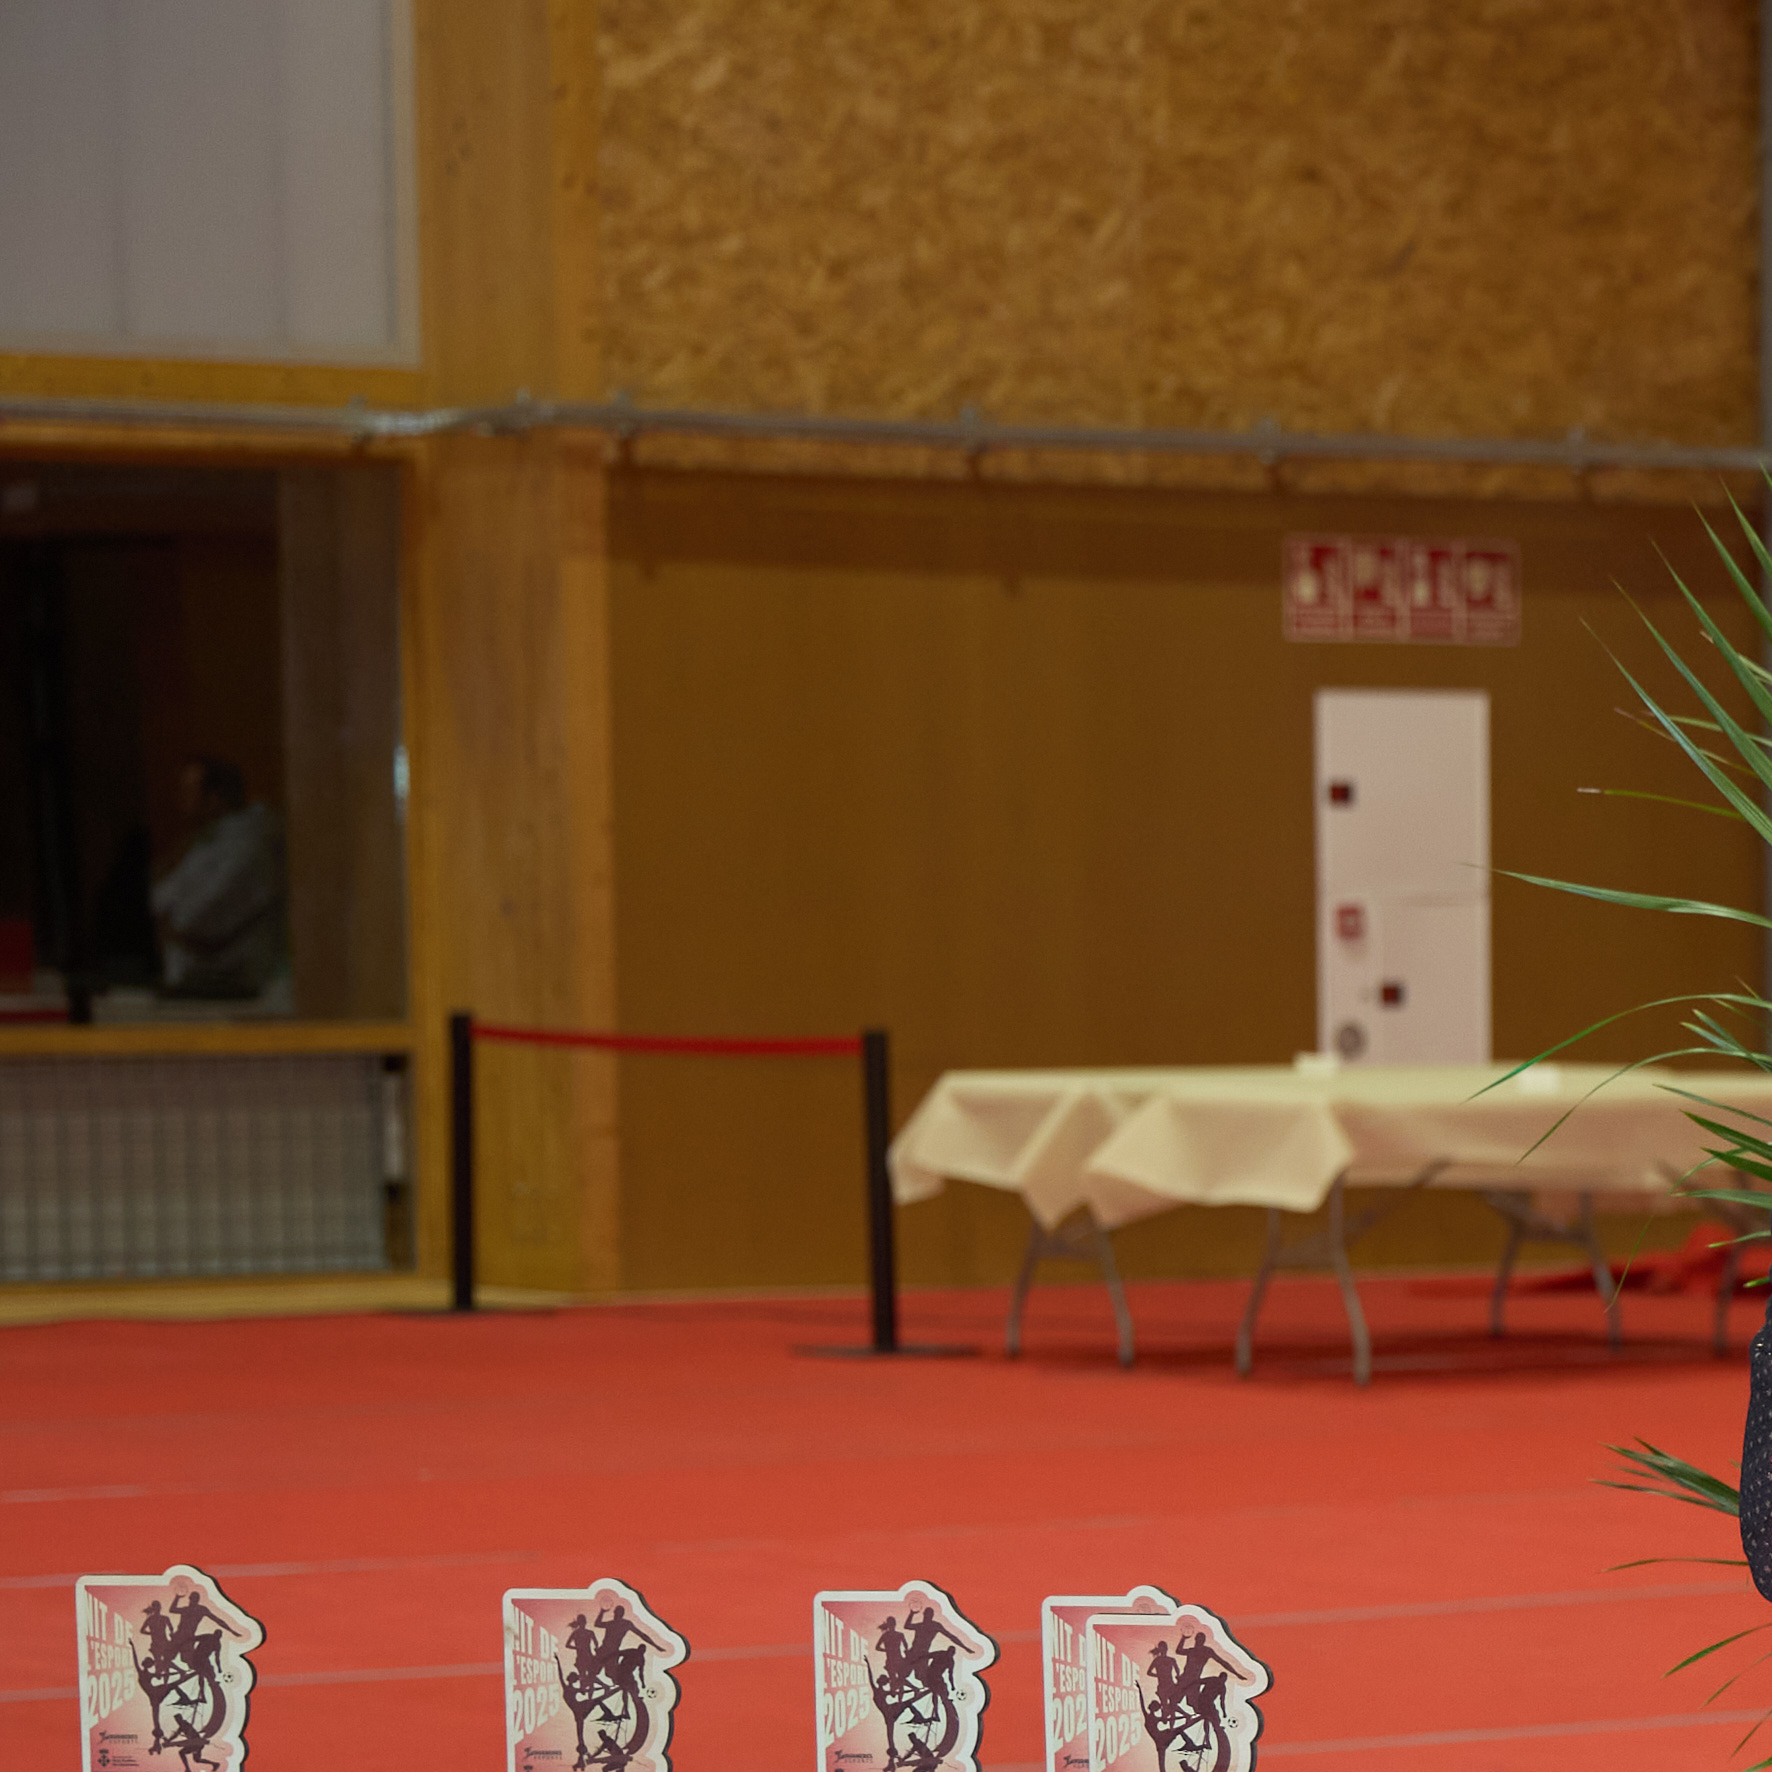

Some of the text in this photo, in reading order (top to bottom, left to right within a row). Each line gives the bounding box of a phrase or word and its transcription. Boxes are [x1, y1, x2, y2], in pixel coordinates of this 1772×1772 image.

[114, 1612, 133, 1647] DE
[540, 1626, 559, 1661] DE
[821, 1607, 869, 1664] NIT DE
[1050, 1610, 1073, 1662] NIT
[1093, 1630, 1140, 1690] NIT DE
[86, 1668, 135, 1729] 2025
[513, 1683, 560, 1745] 2025
[823, 1686, 870, 1749] 2025
[1052, 1693, 1088, 1754] 202
